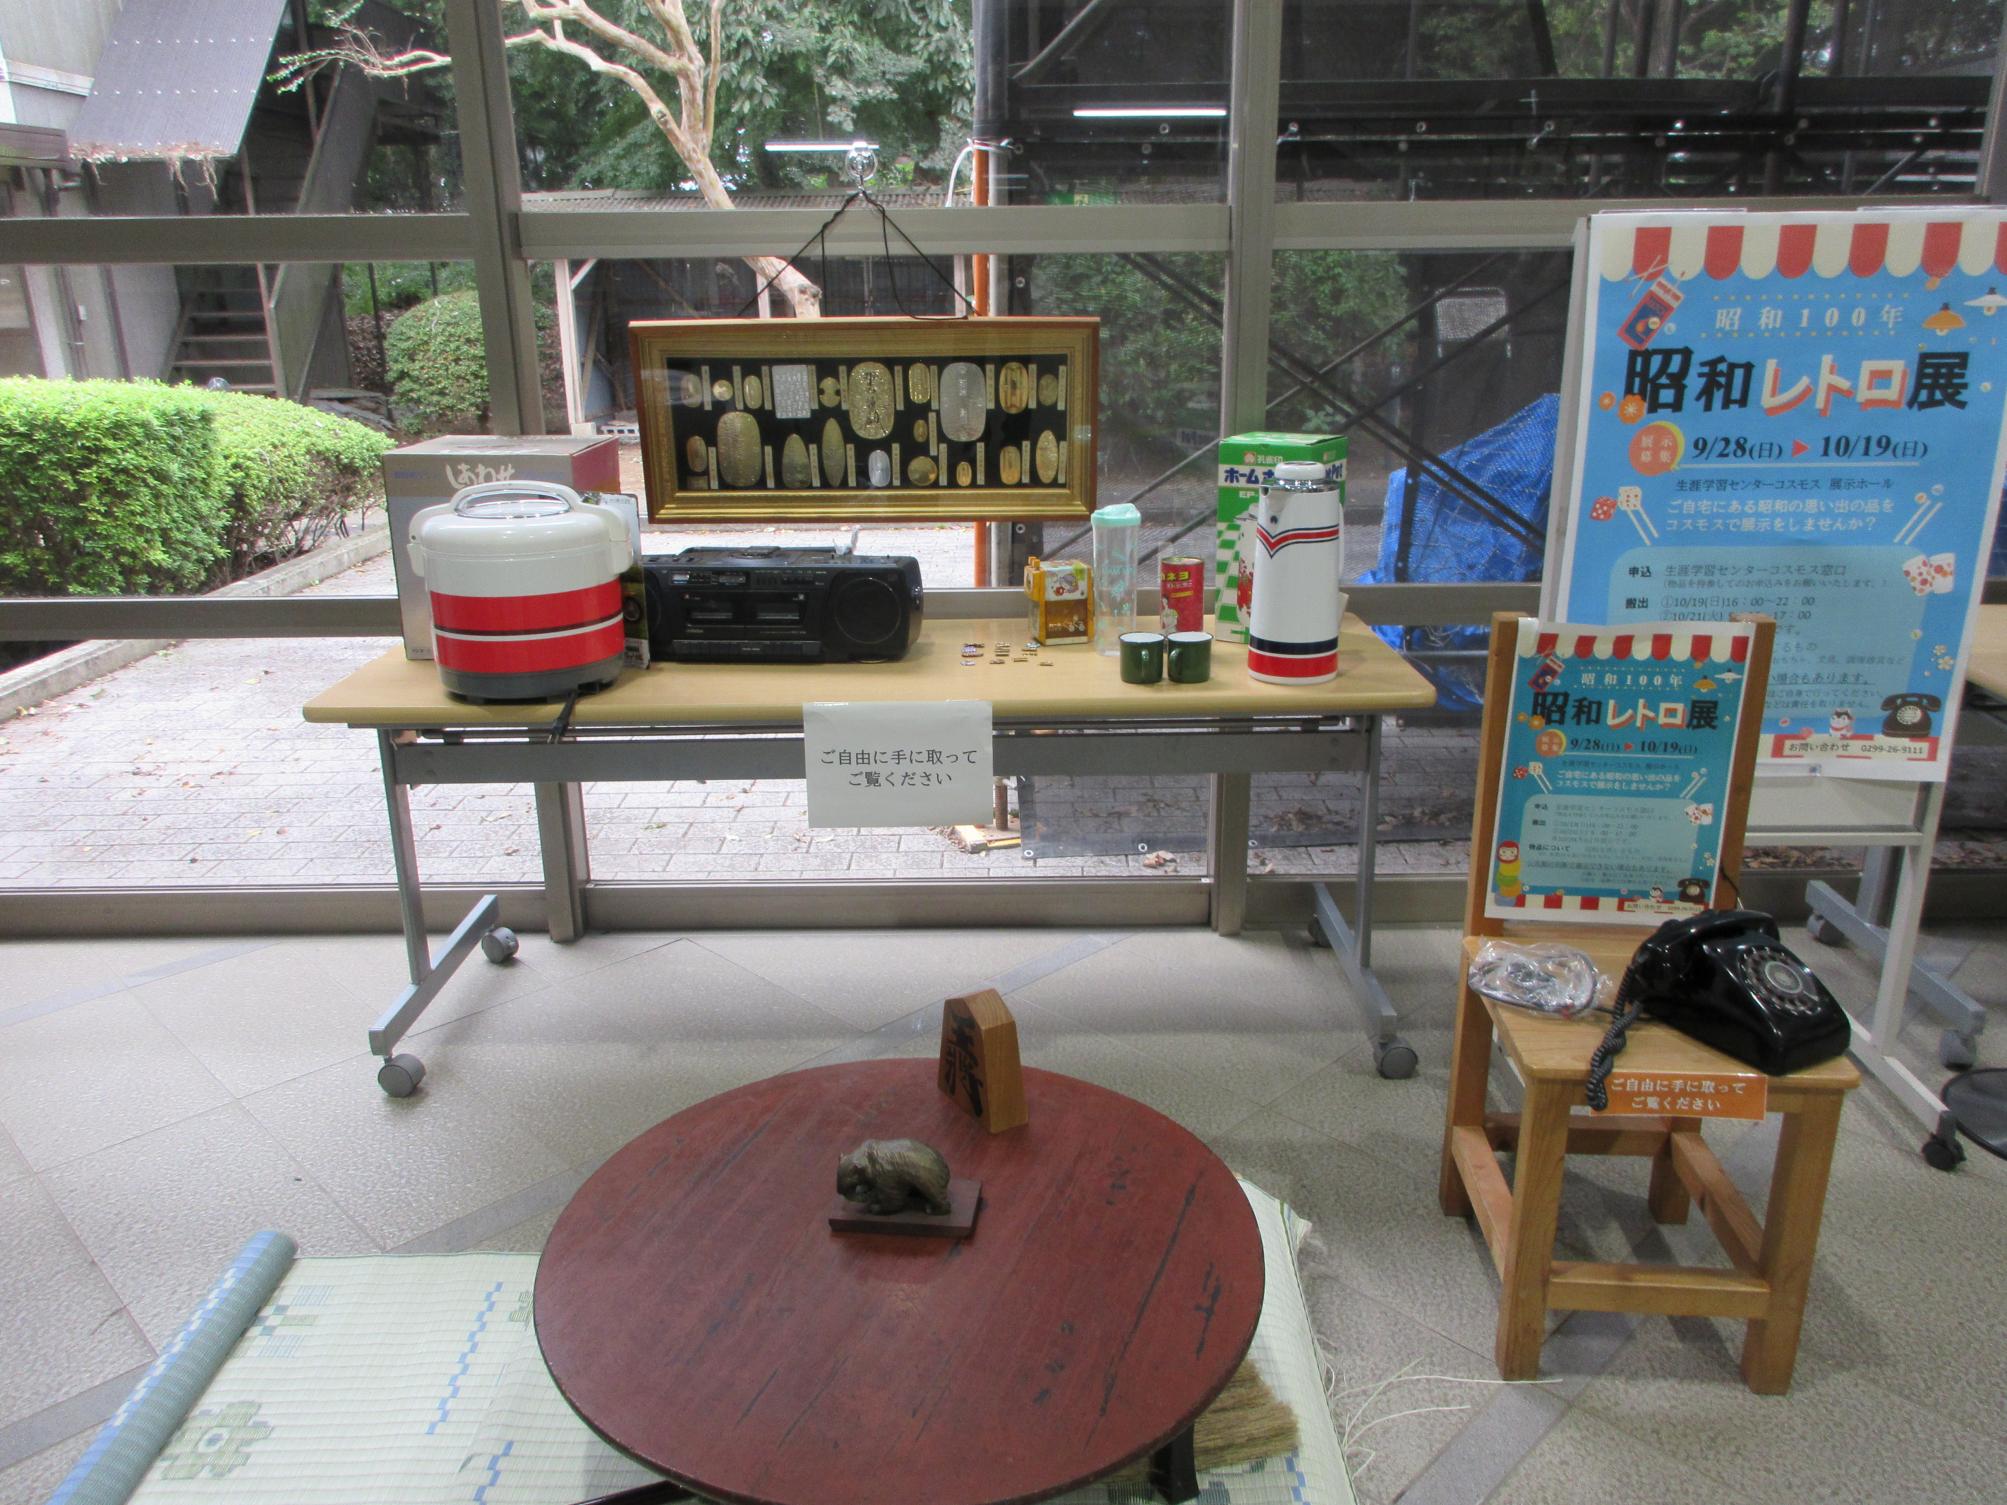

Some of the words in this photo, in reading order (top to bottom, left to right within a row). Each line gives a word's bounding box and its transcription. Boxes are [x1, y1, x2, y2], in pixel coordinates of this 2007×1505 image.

[1714, 304, 1905, 330] 昭和100年
[1624, 345, 1970, 417] 昭和レトロ展
[1692, 435, 1784, 460] 9/28(日)
[1819, 435, 1929, 459] 10/19(日)
[1676, 478, 1821, 492] 生涯学習センターコスモス
[1829, 477, 1894, 491] 展示ホール
[1667, 498, 1895, 515] ご自宅にある昭和の思い出の品を
[1628, 565, 1652, 578] 申込
[1664, 562, 1847, 578] 生涯学習センターコスモス窓口
[1531, 690, 1719, 731] 昭和レトロ展
[1788, 742, 1851, 753] お問い合わせ
[820, 748, 978, 766] ご自由に手に取って
[848, 771, 953, 788] ご覧ください
[1611, 1077, 1748, 1095] ご自由に手に取って
[1631, 1096, 1721, 1111] ご覧ください
